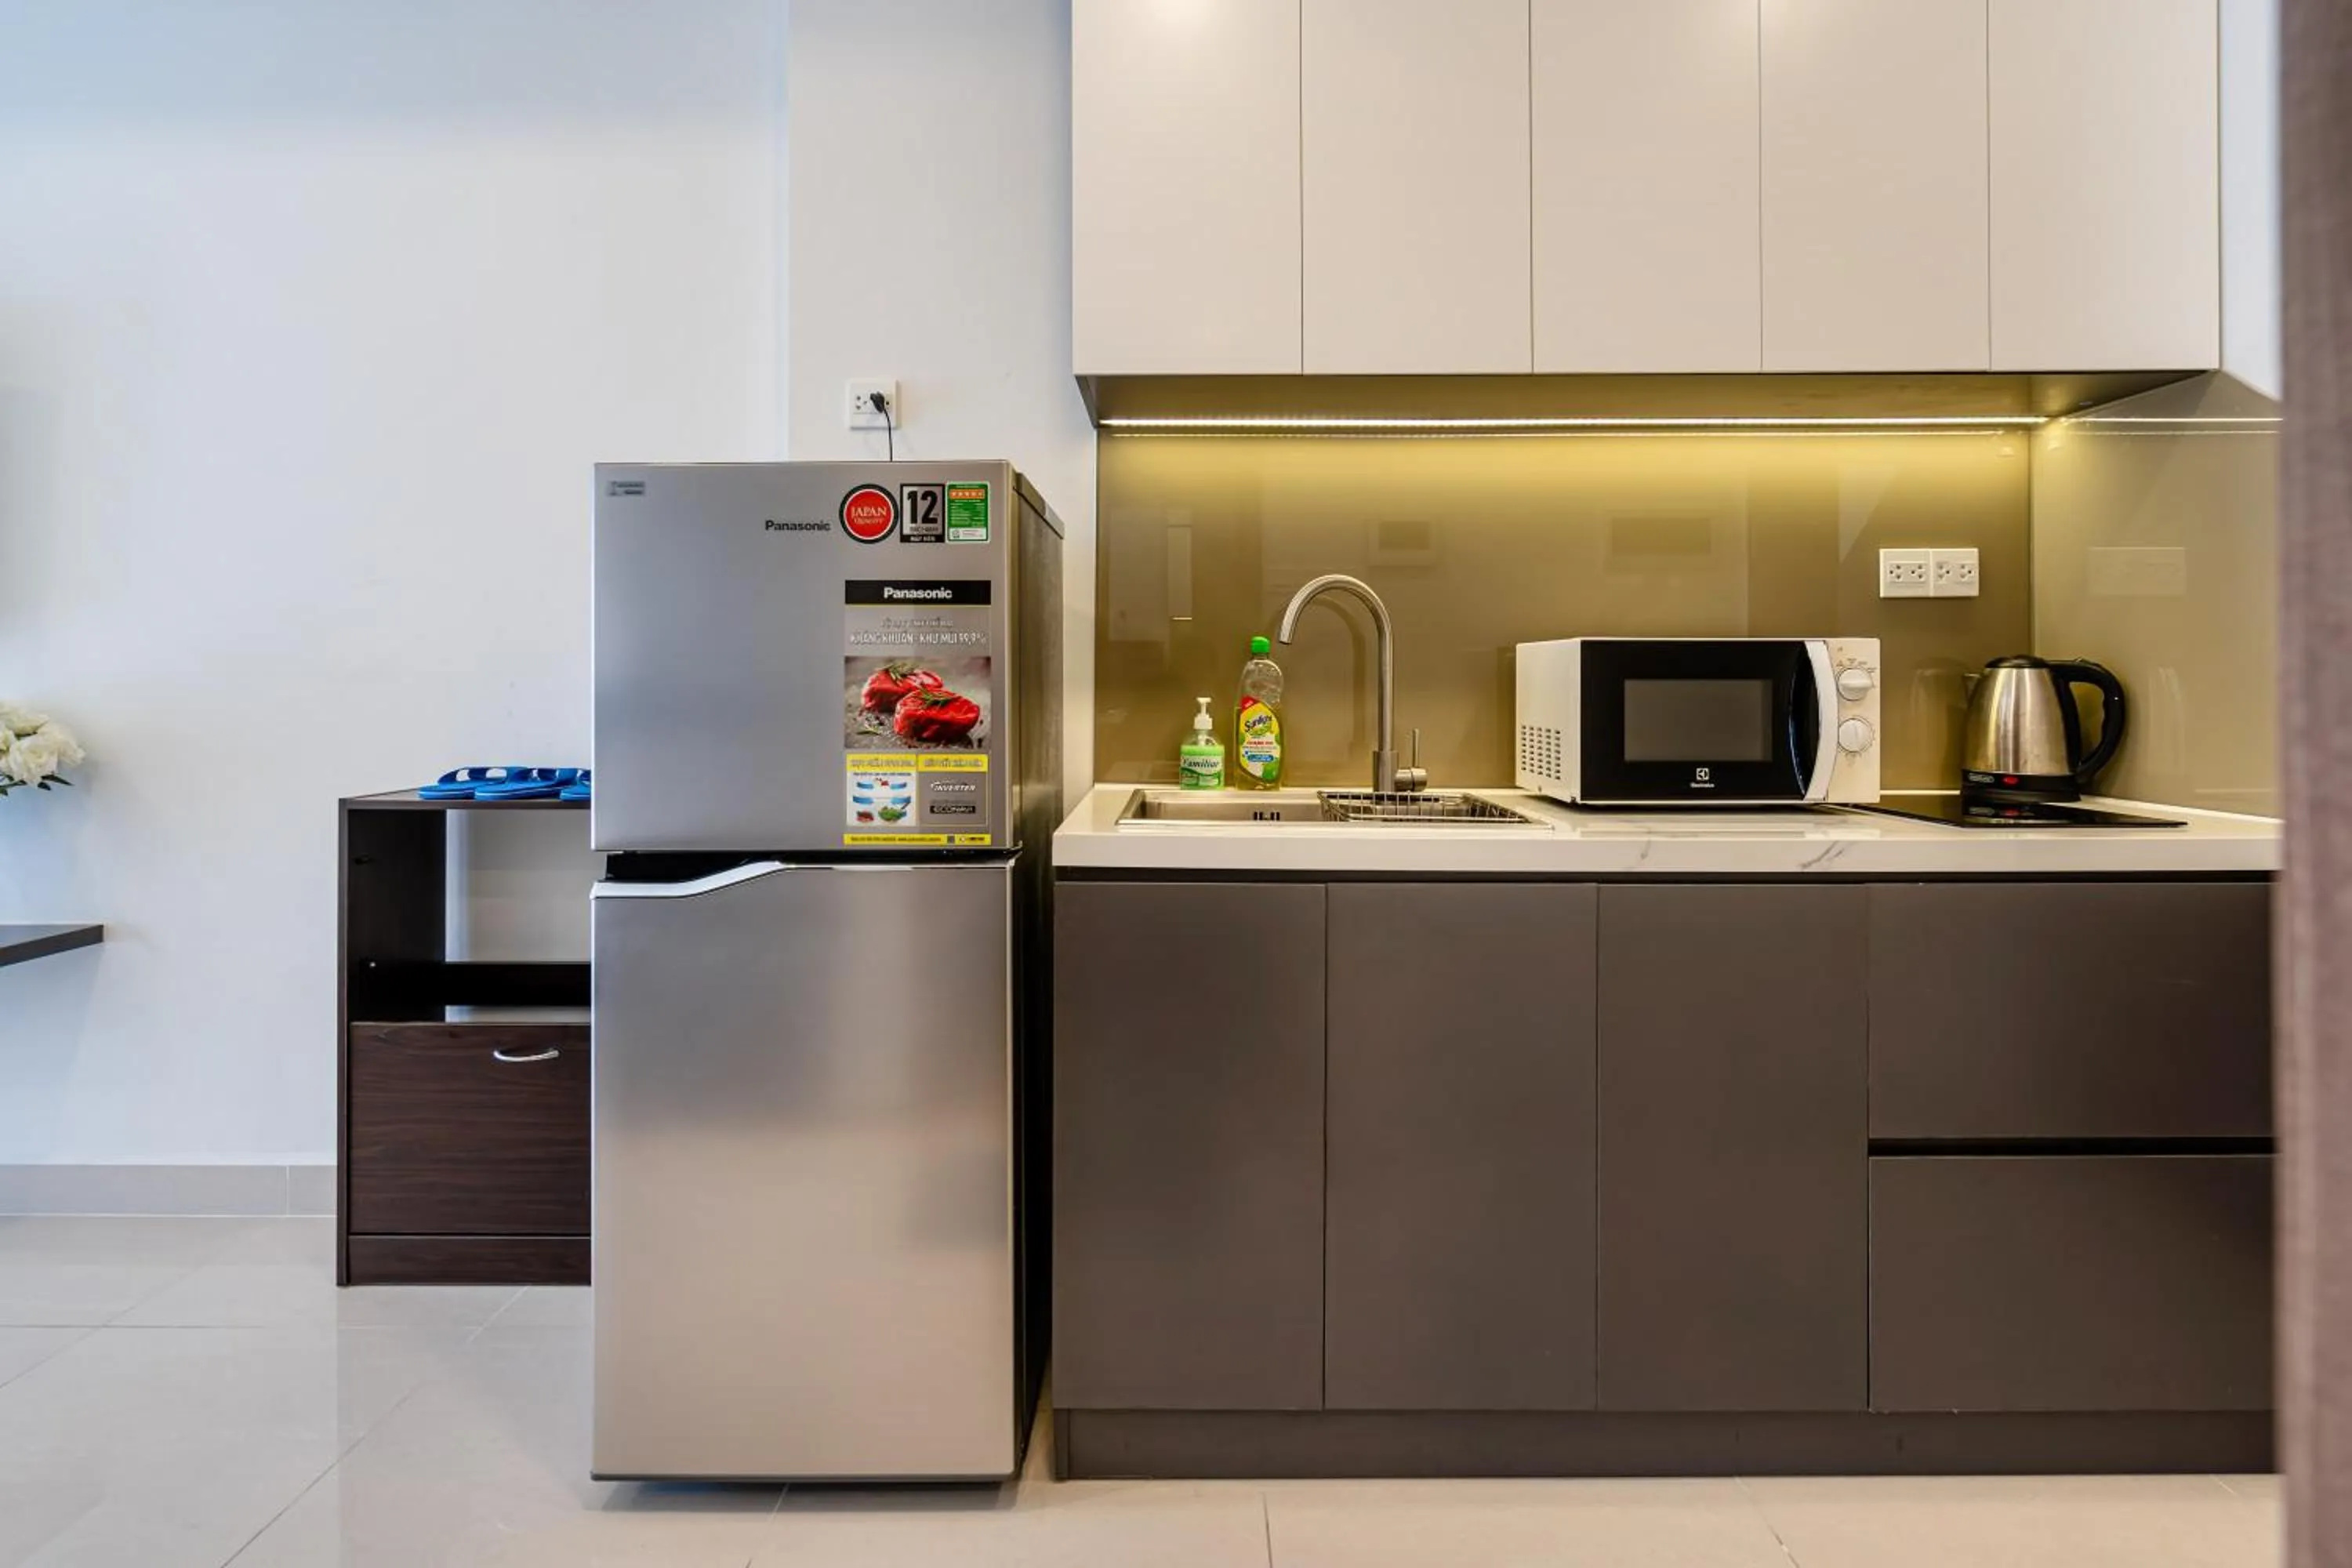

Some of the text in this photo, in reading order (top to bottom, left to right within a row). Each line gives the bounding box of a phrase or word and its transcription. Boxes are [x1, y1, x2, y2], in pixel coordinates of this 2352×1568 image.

[851, 506, 887, 518] JAPAN
[907, 490, 938, 524] 12
[765, 520, 831, 531] Panasonic
[884, 586, 953, 599] Panasonic
